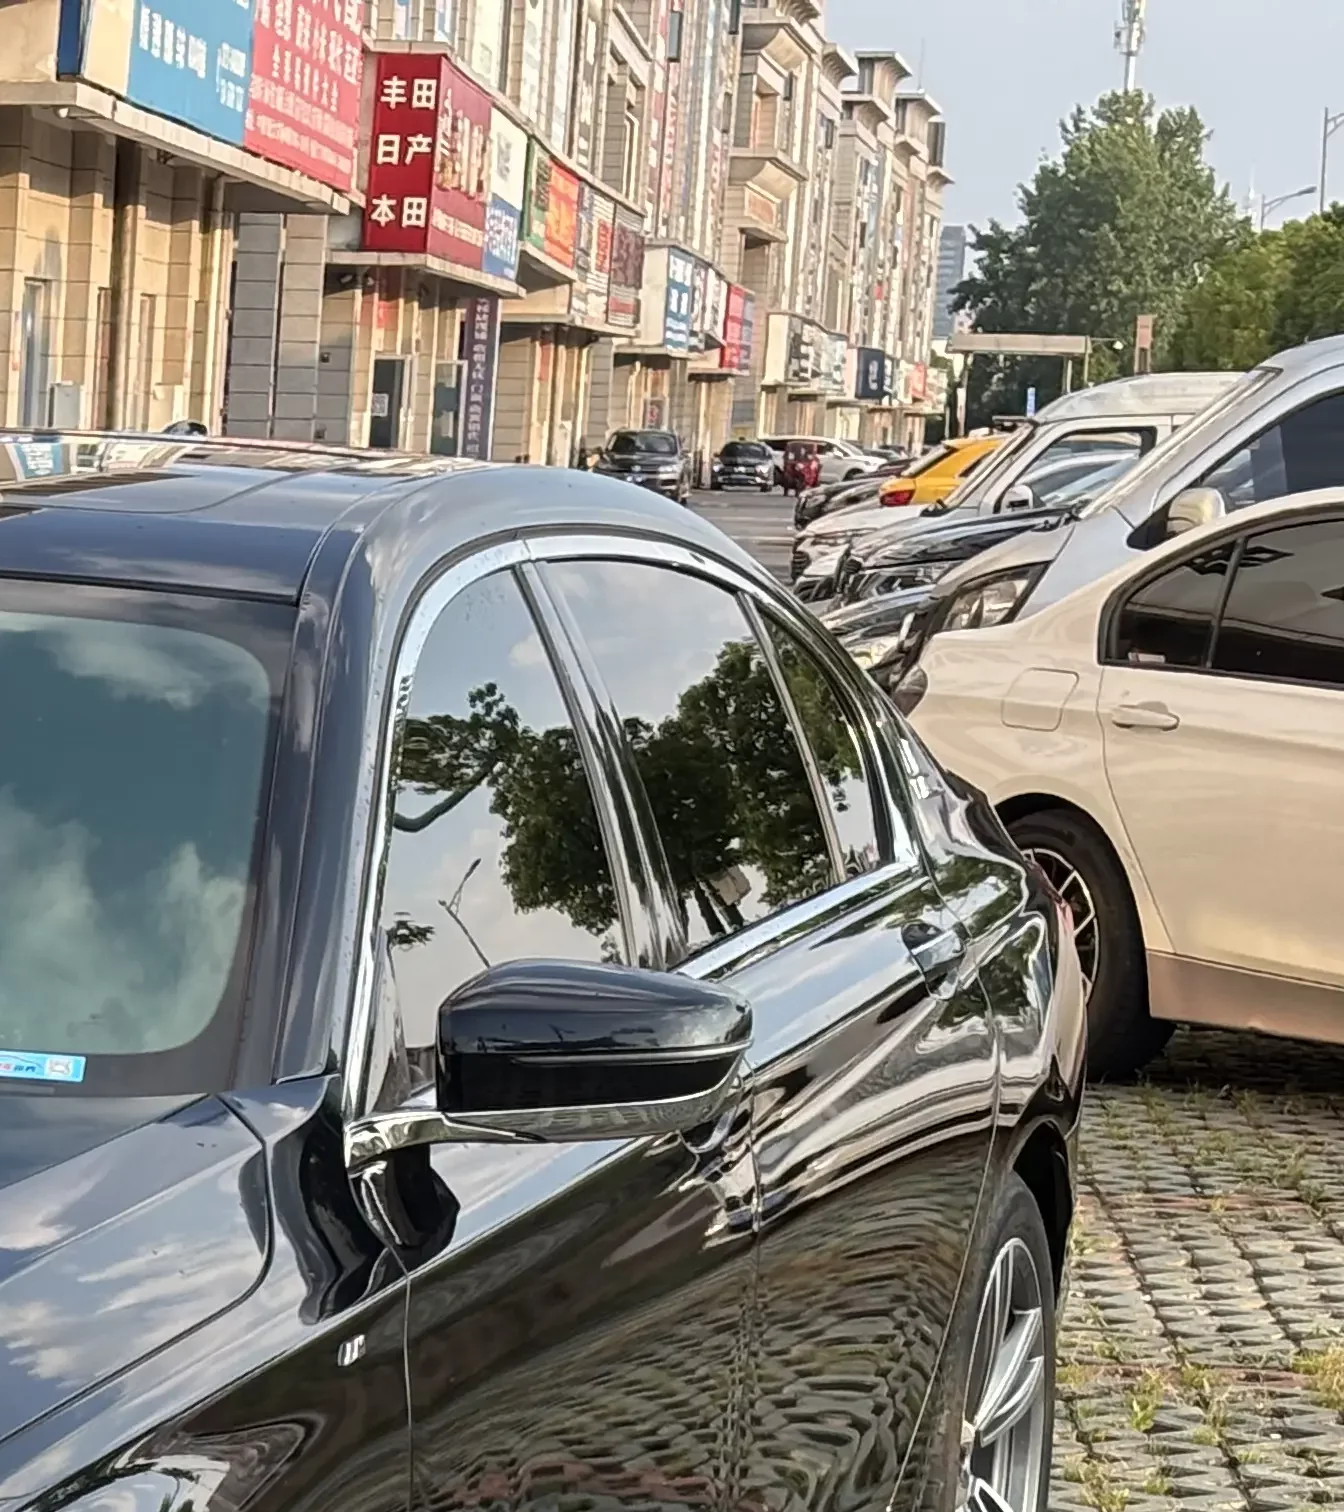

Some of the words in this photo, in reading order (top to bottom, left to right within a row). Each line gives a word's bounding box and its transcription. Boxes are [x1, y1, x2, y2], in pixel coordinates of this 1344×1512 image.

[380, 76, 437, 110] 丰田
[376, 133, 433, 165] 日产
[370, 194, 428, 228] 本田
